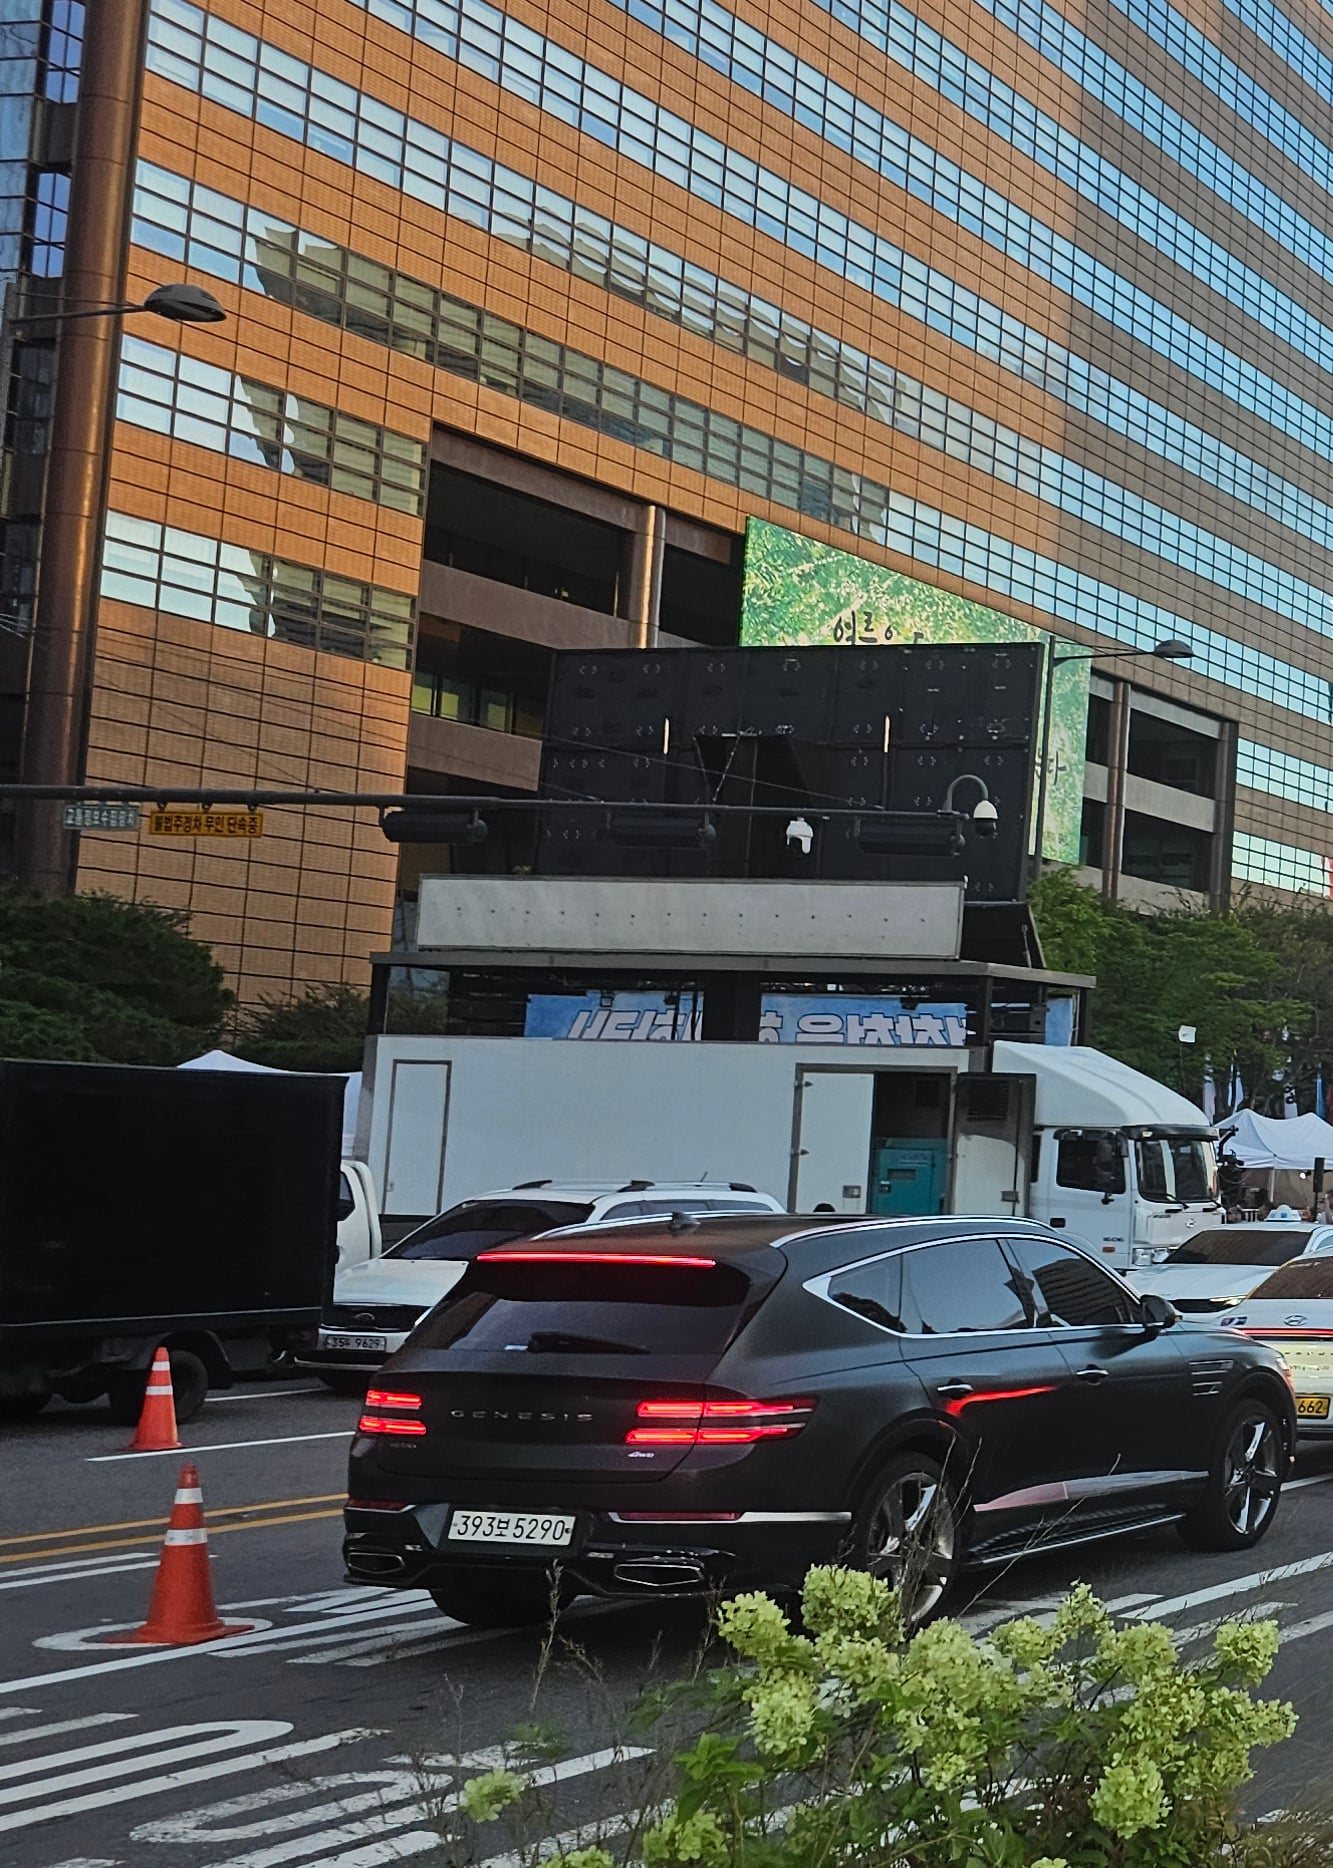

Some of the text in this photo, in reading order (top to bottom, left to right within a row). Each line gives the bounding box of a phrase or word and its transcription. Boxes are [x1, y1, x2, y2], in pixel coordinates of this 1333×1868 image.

[154, 814, 260, 835] 불법주정차 무인 단속중
[1297, 1400, 1324, 1415] 662
[450, 1409, 593, 1422] GENESIS
